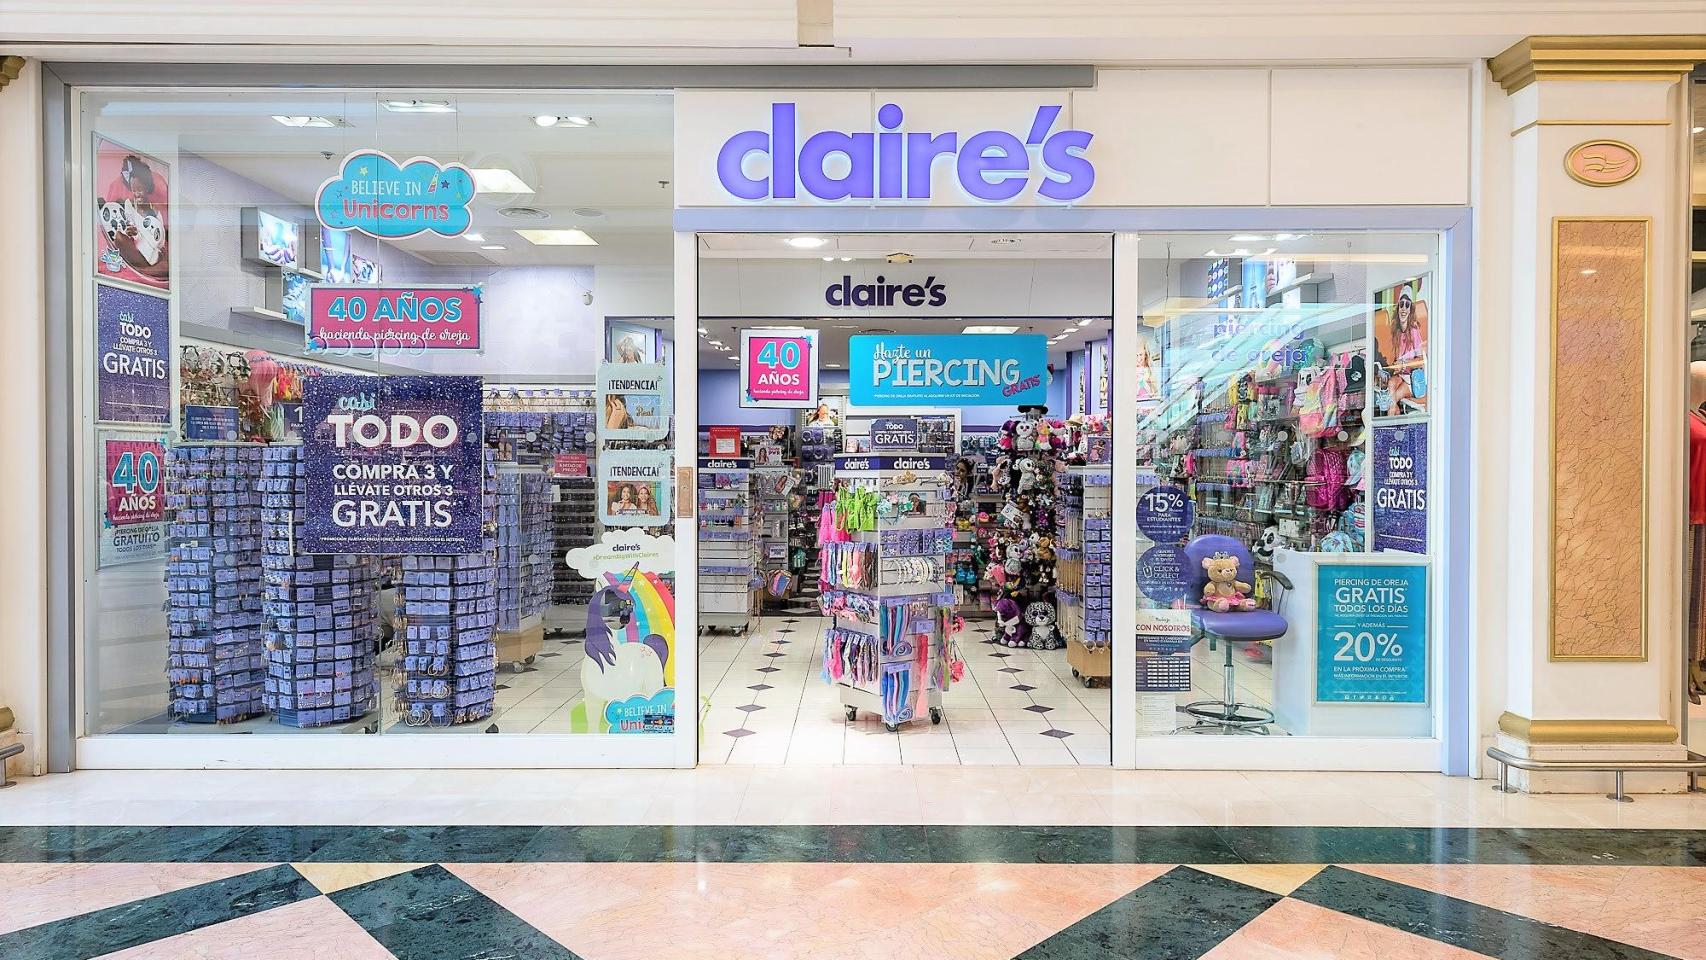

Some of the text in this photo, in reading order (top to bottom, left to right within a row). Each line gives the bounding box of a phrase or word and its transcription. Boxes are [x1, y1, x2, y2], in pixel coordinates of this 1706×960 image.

[717, 102, 1095, 200] claire's
[351, 179, 422, 196] BELIEVE IN
[343, 199, 449, 221] Unicorns
[825, 275, 947, 307] claire's
[328, 291, 462, 323] 40 AÑOS
[120, 322, 151, 340] TODO
[319, 326, 471, 345] haciendo piercing de oreja
[120, 336, 143, 347] COMPRA
[136, 346, 153, 356] OTROS
[757, 341, 800, 370] 40
[873, 342, 931, 364] Hazte un
[1247, 344, 1306, 367] oreja
[103, 352, 166, 380] GRATIS
[873, 358, 1020, 387] PIERCING
[609, 379, 658, 391] ¡TENDENCIA!
[757, 371, 800, 386] AÑOS
[1002, 374, 1041, 398] GRATIS
[338, 392, 376, 412] casi
[327, 414, 458, 449] TODO
[875, 434, 914, 445] GRATIS
[610, 466, 660, 477] ¡TENDENCIA!
[707, 460, 738, 469] claire's
[844, 458, 869, 470] claire's
[893, 458, 931, 470] claire's
[1389, 456, 1413, 470] TODO
[112, 451, 160, 494] 40
[332, 464, 454, 480] COMPRA 3 Y
[334, 480, 454, 497] LLÉVATE OTROS 3
[118, 493, 156, 512] AÑOS
[1145, 493, 1184, 512] 15%
[1377, 487, 1426, 511] GRATIS
[332, 499, 456, 528] GRATIS
[113, 532, 160, 547] GRATUITO
[612, 543, 641, 552] claire's
[1334, 578, 1409, 586] PIERCING DE OREJA
[1335, 587, 1406, 604] GRATIS
[1334, 603, 1409, 613] TODOS LOS DÍAS
[1136, 623, 1191, 632] CON NOSOTROS
[1334, 631, 1403, 662] 20%
[1352, 665, 1379, 673] PRÓXIMA
[624, 703, 667, 717] BELIEVE IN
